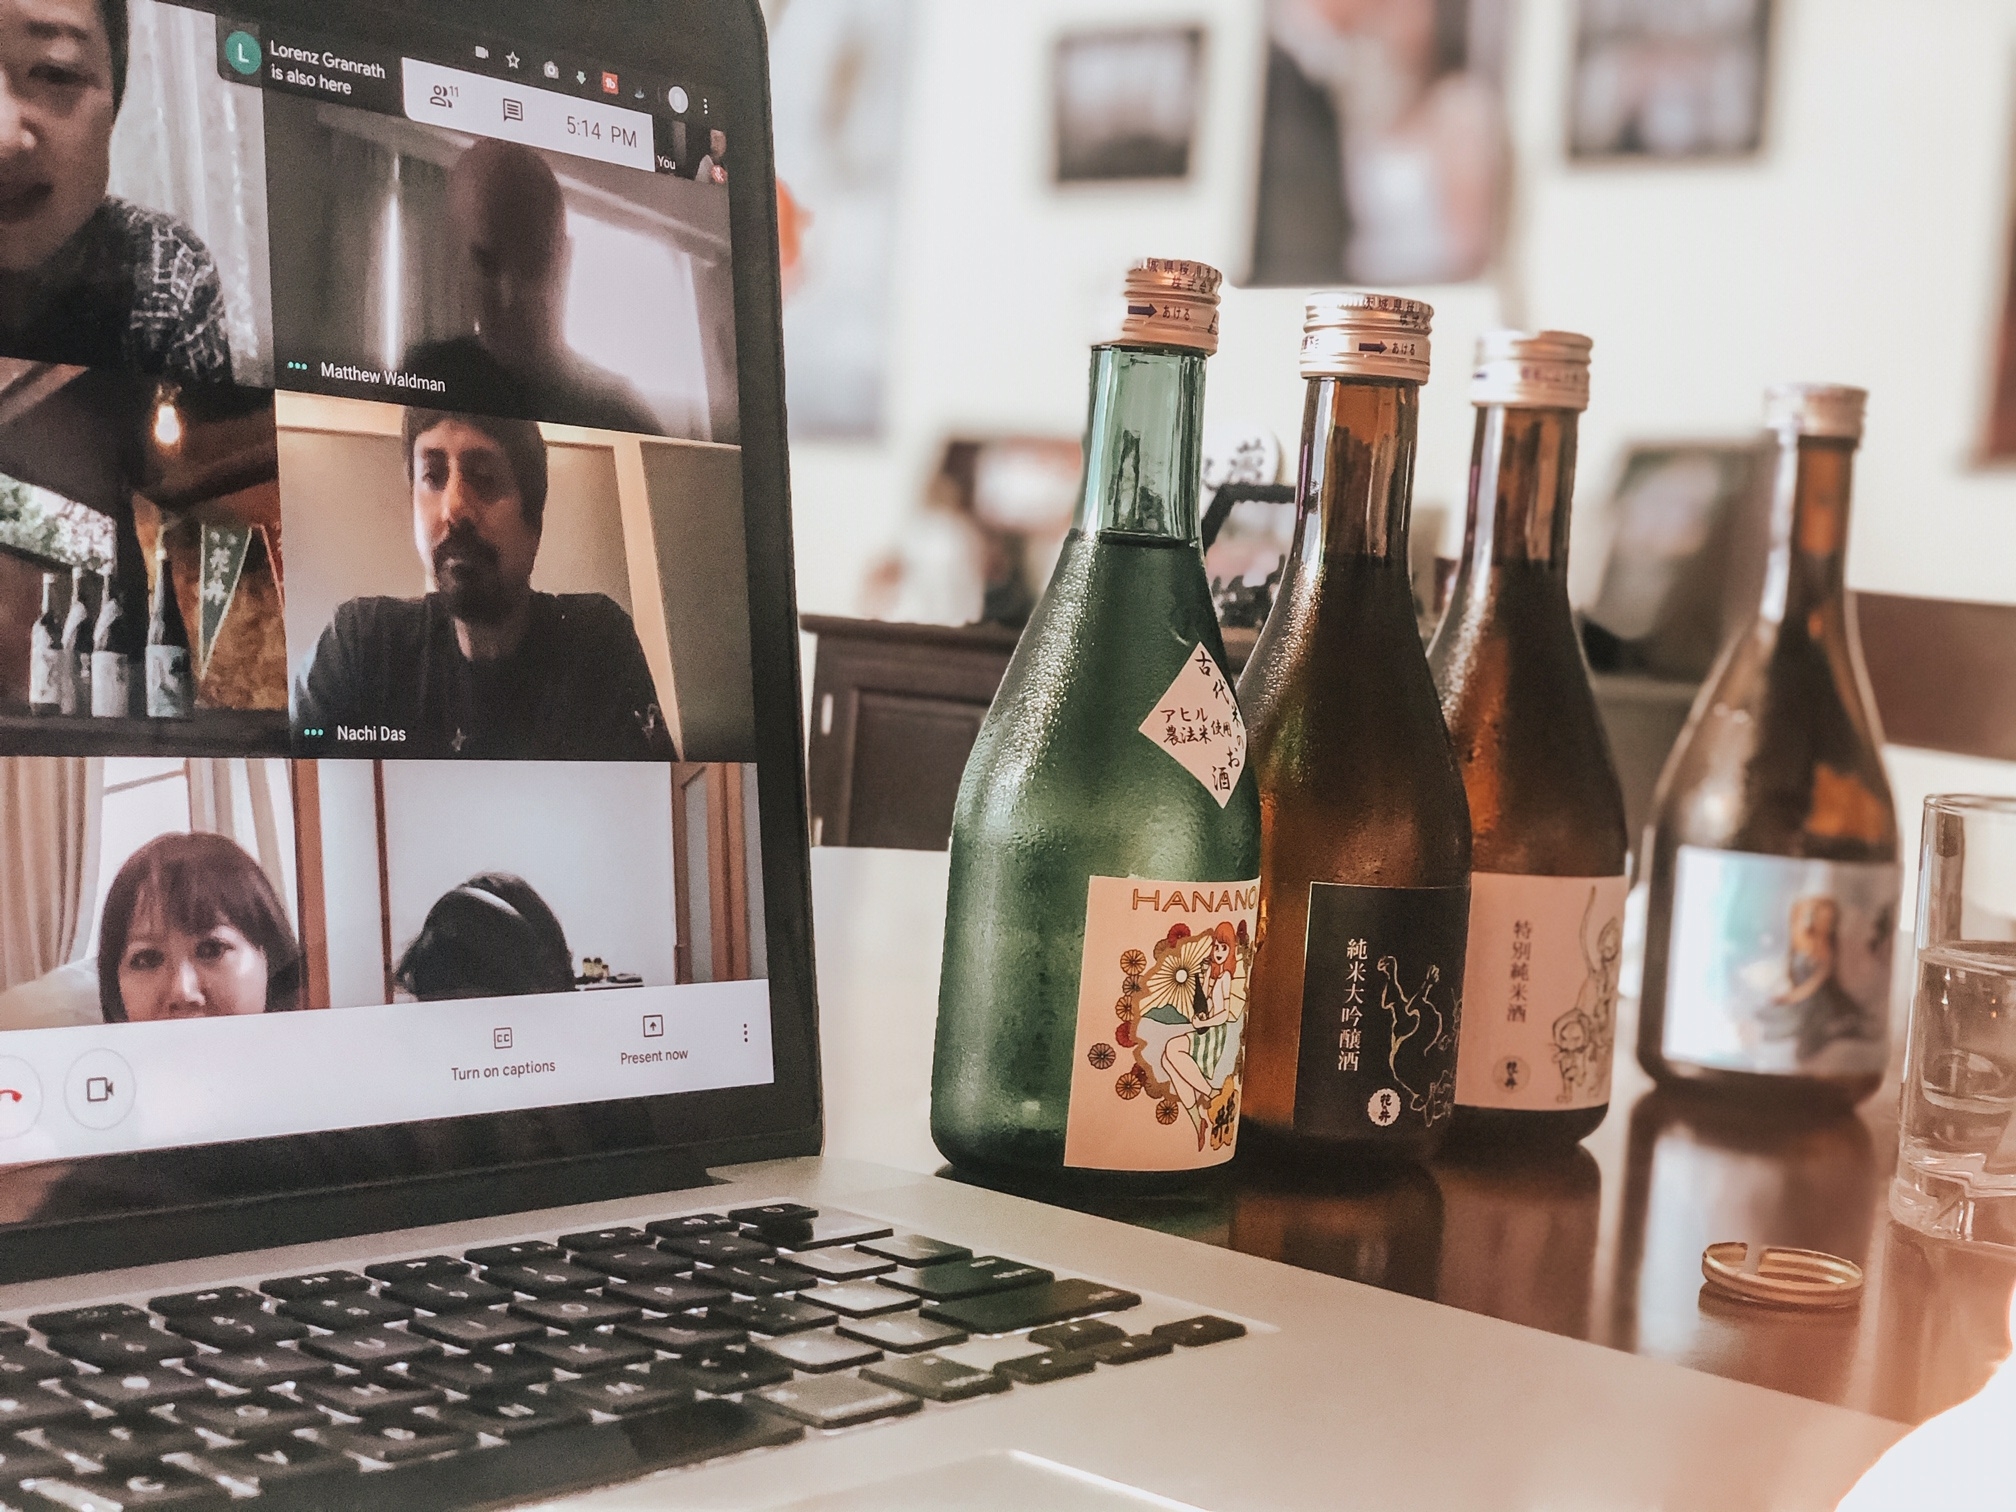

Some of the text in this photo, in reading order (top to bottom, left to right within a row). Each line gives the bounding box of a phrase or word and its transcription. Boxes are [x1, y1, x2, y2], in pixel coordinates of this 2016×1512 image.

[238, 43, 249, 63] L
[270, 40, 386, 79] Lorenz Granrath
[271, 64, 352, 94] is also here
[448, 86, 459, 97] 11
[566, 116, 637, 148] 5:14 PM
[657, 155, 676, 170] You
[1162, 305, 1190, 321] あける
[1391, 342, 1416, 356] あける
[320, 361, 446, 392] Matthew Waldman
[1160, 707, 1209, 724] アヒル
[337, 724, 406, 742] Nachi Das
[1506, 919, 1531, 1023] 特別純米酒
[1337, 938, 1368, 1072] 純米大吟醸酒
[620, 1049, 688, 1065] Present now
[451, 1060, 556, 1081] Turn on captions
